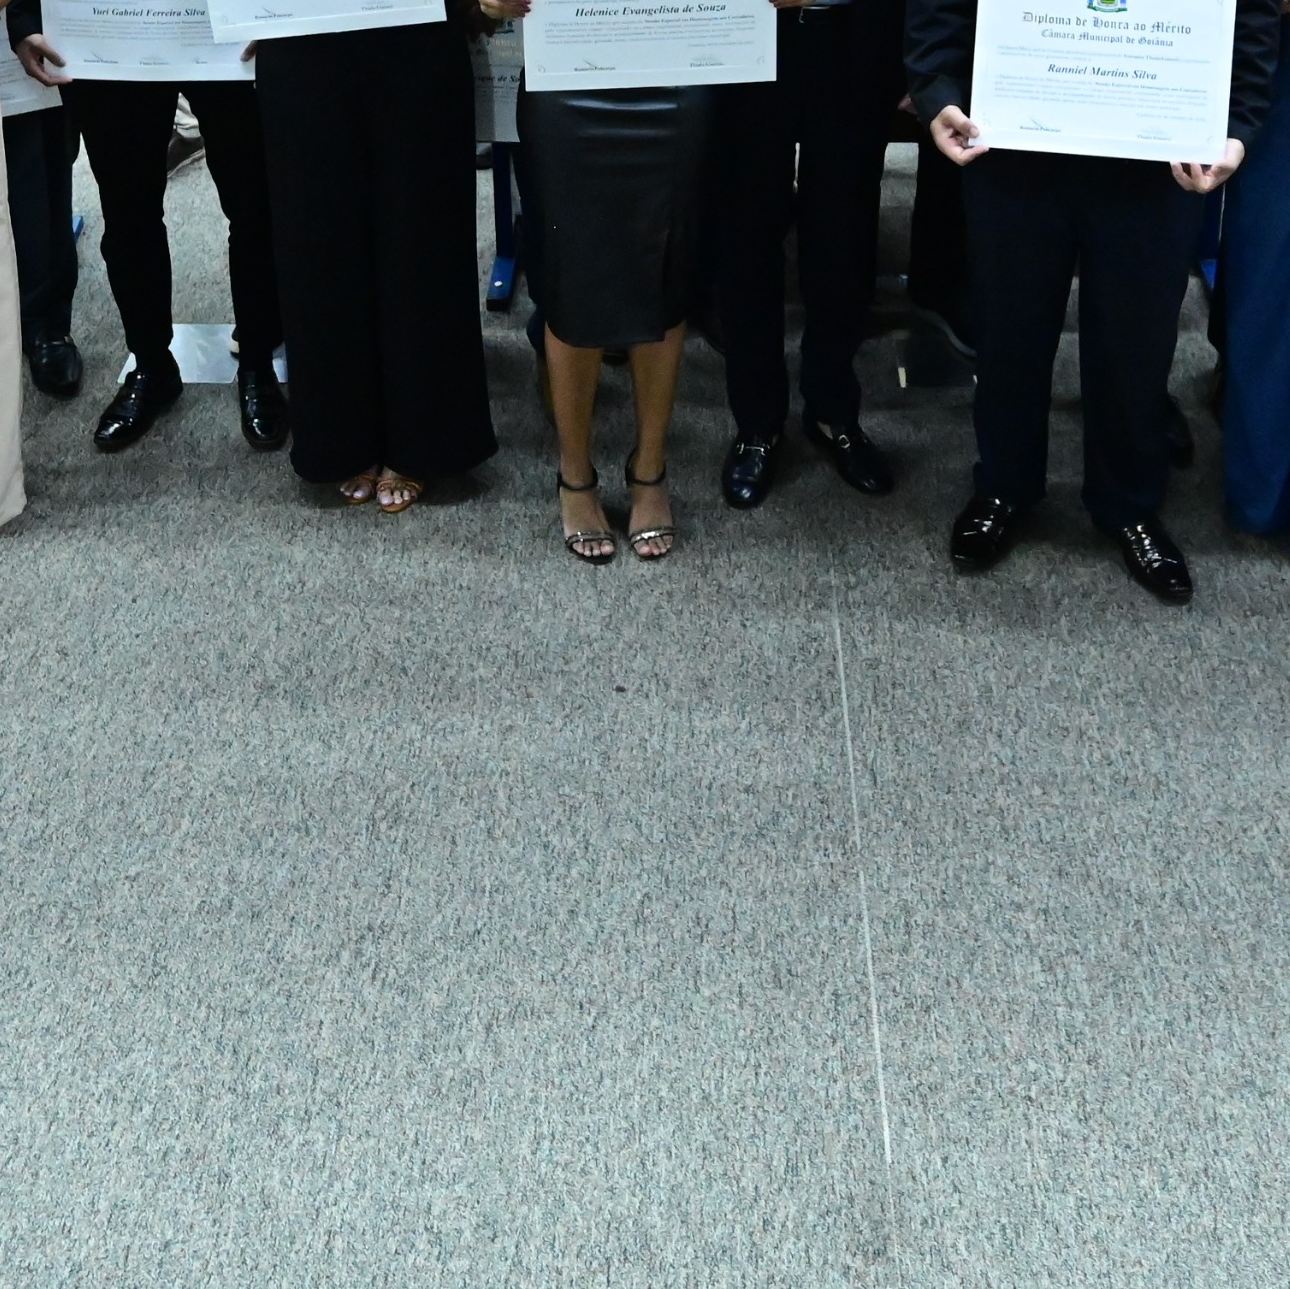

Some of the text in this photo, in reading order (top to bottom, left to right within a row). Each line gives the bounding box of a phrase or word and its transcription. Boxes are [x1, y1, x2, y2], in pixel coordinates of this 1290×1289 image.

[575, 8, 619, 16] Helenice
[622, 6, 680, 16] Evangelista
[682, 5, 695, 13] de
[1023, 12, 1191, 34] Diploma de Honra ao Mérito
[1126, 36, 1135, 44] de
[1047, 64, 1158, 80] Ranniel Martins Silva
